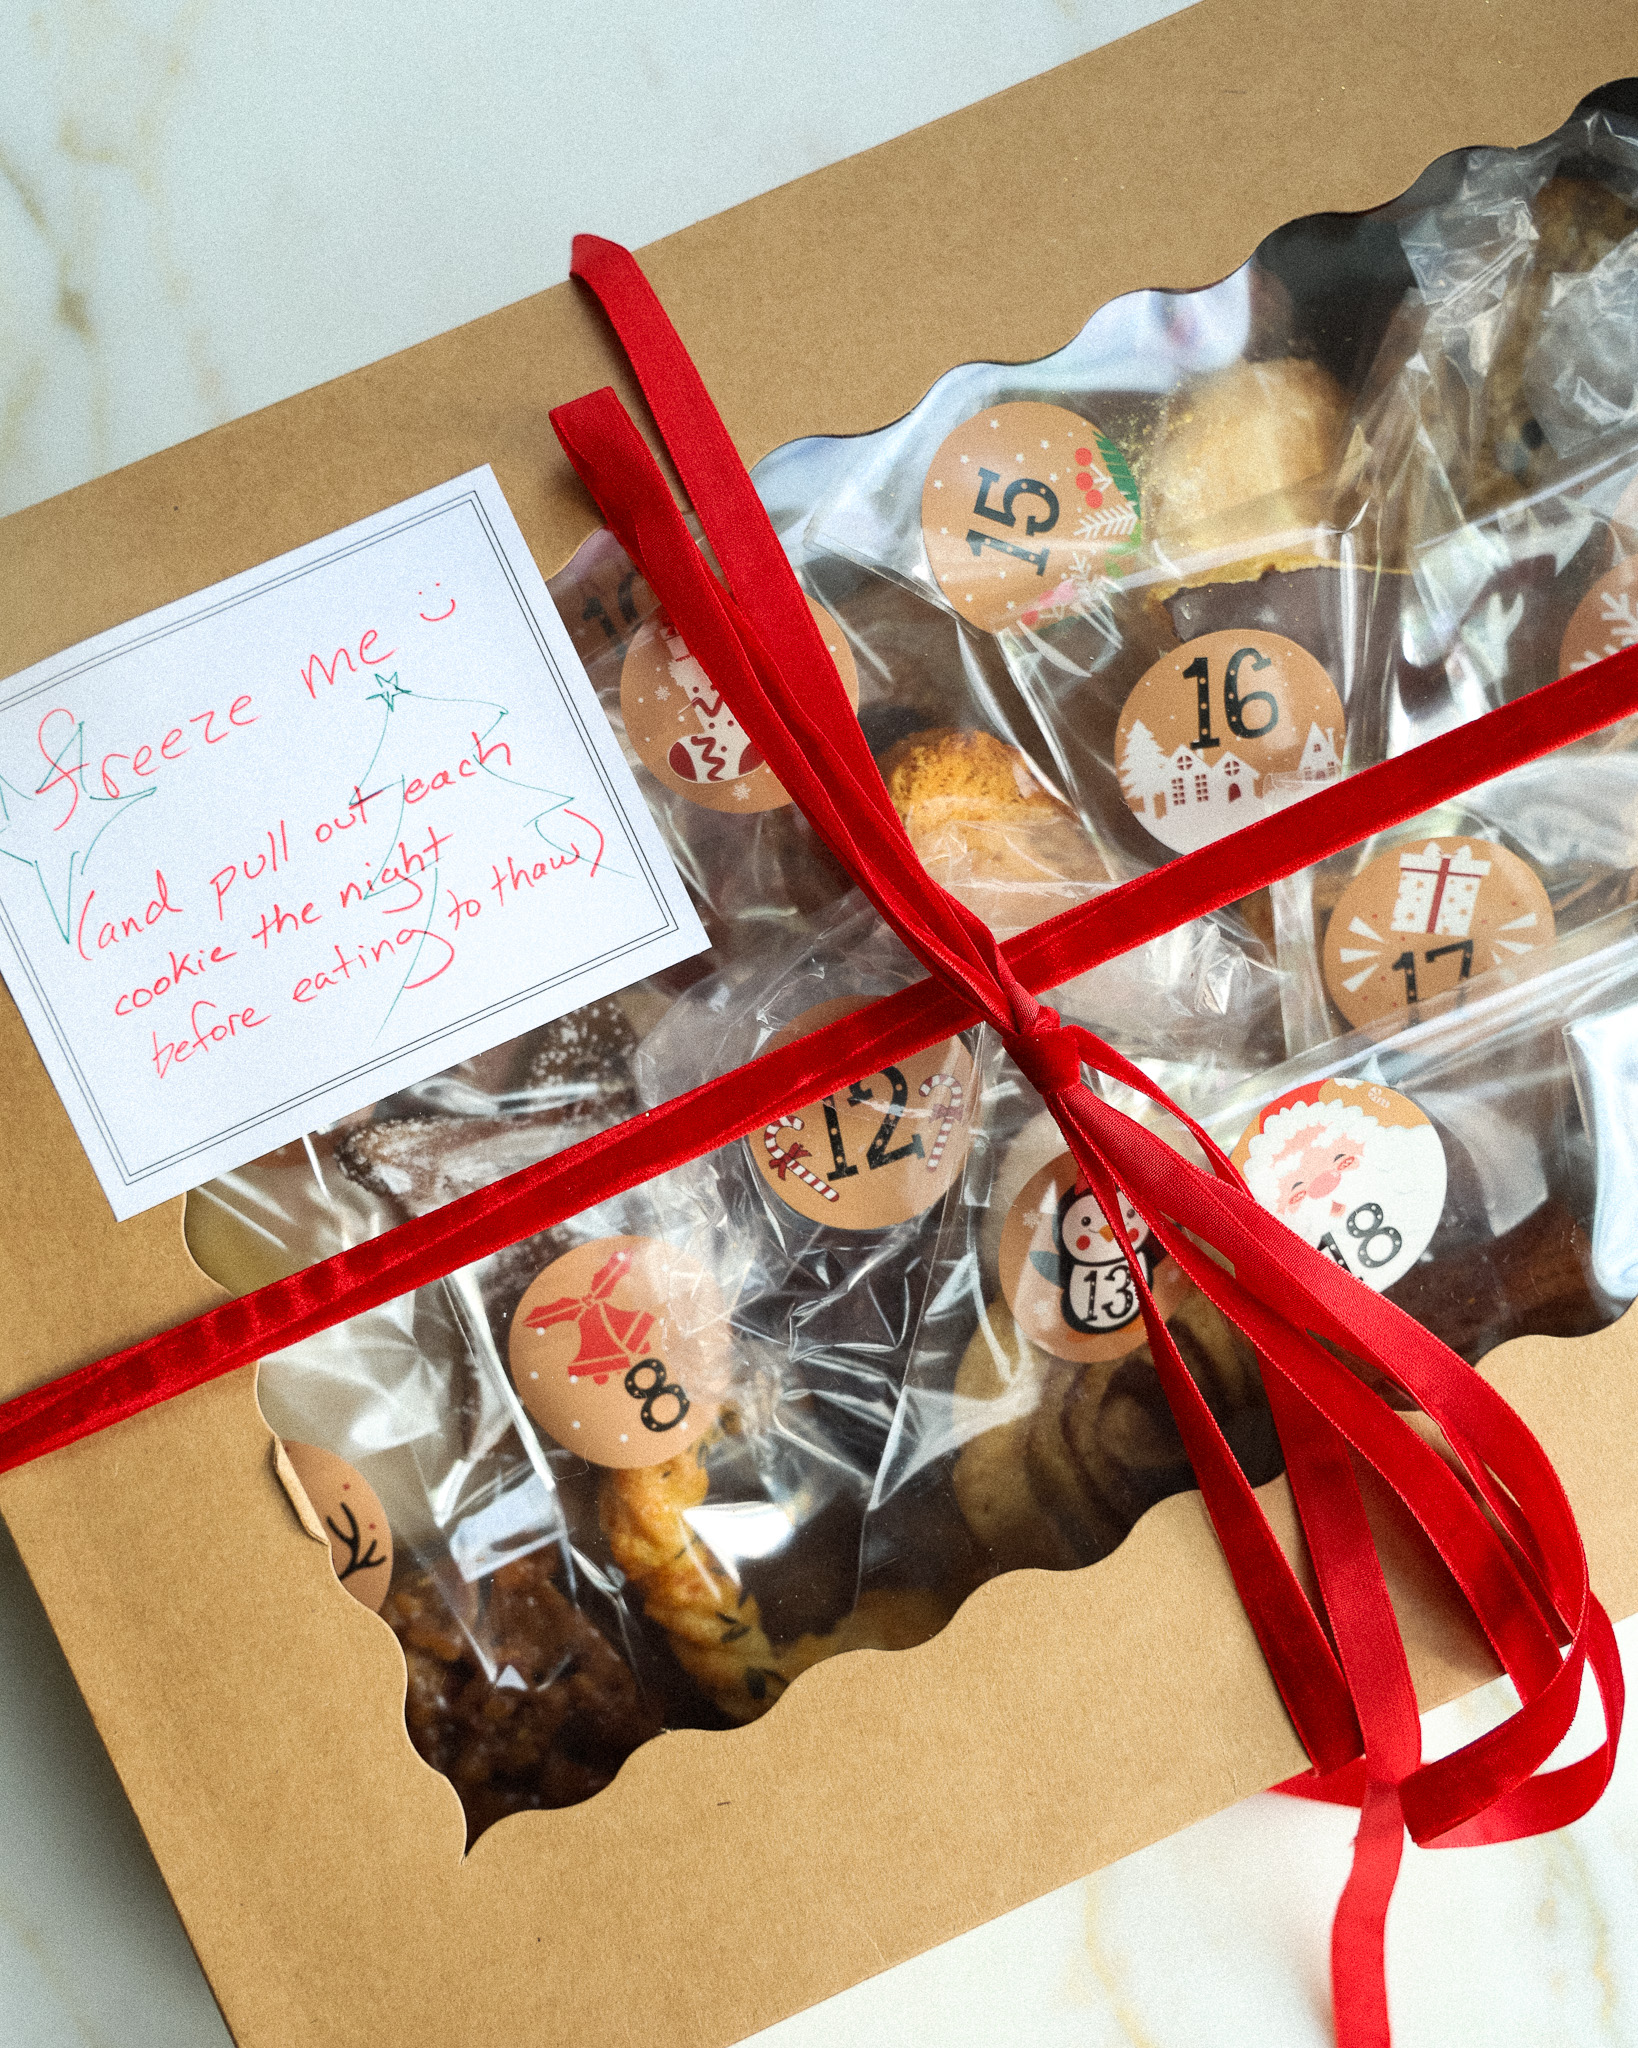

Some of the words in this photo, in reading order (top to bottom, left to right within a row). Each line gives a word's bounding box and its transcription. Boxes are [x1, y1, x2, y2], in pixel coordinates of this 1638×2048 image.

[966, 467, 1060, 576] 15
[1182, 648, 1279, 750] 16
[78, 869, 183, 961] (and
[210, 819, 289, 921] pull
[316, 786, 384, 843] out
[404, 731, 513, 806] each
[115, 945, 237, 1017] cookie
[252, 902, 323, 950] the
[340, 826, 455, 914] night
[152, 1000, 271, 1079] before
[293, 928, 455, 1003] eating
[447, 889, 482, 931] to
[491, 809, 605, 908] thaw)
[1392, 939, 1474, 1030] 17
[822, 1066, 925, 1182] 12
[1083, 1264, 1133, 1323] 13
[624, 1358, 690, 1433] 8
